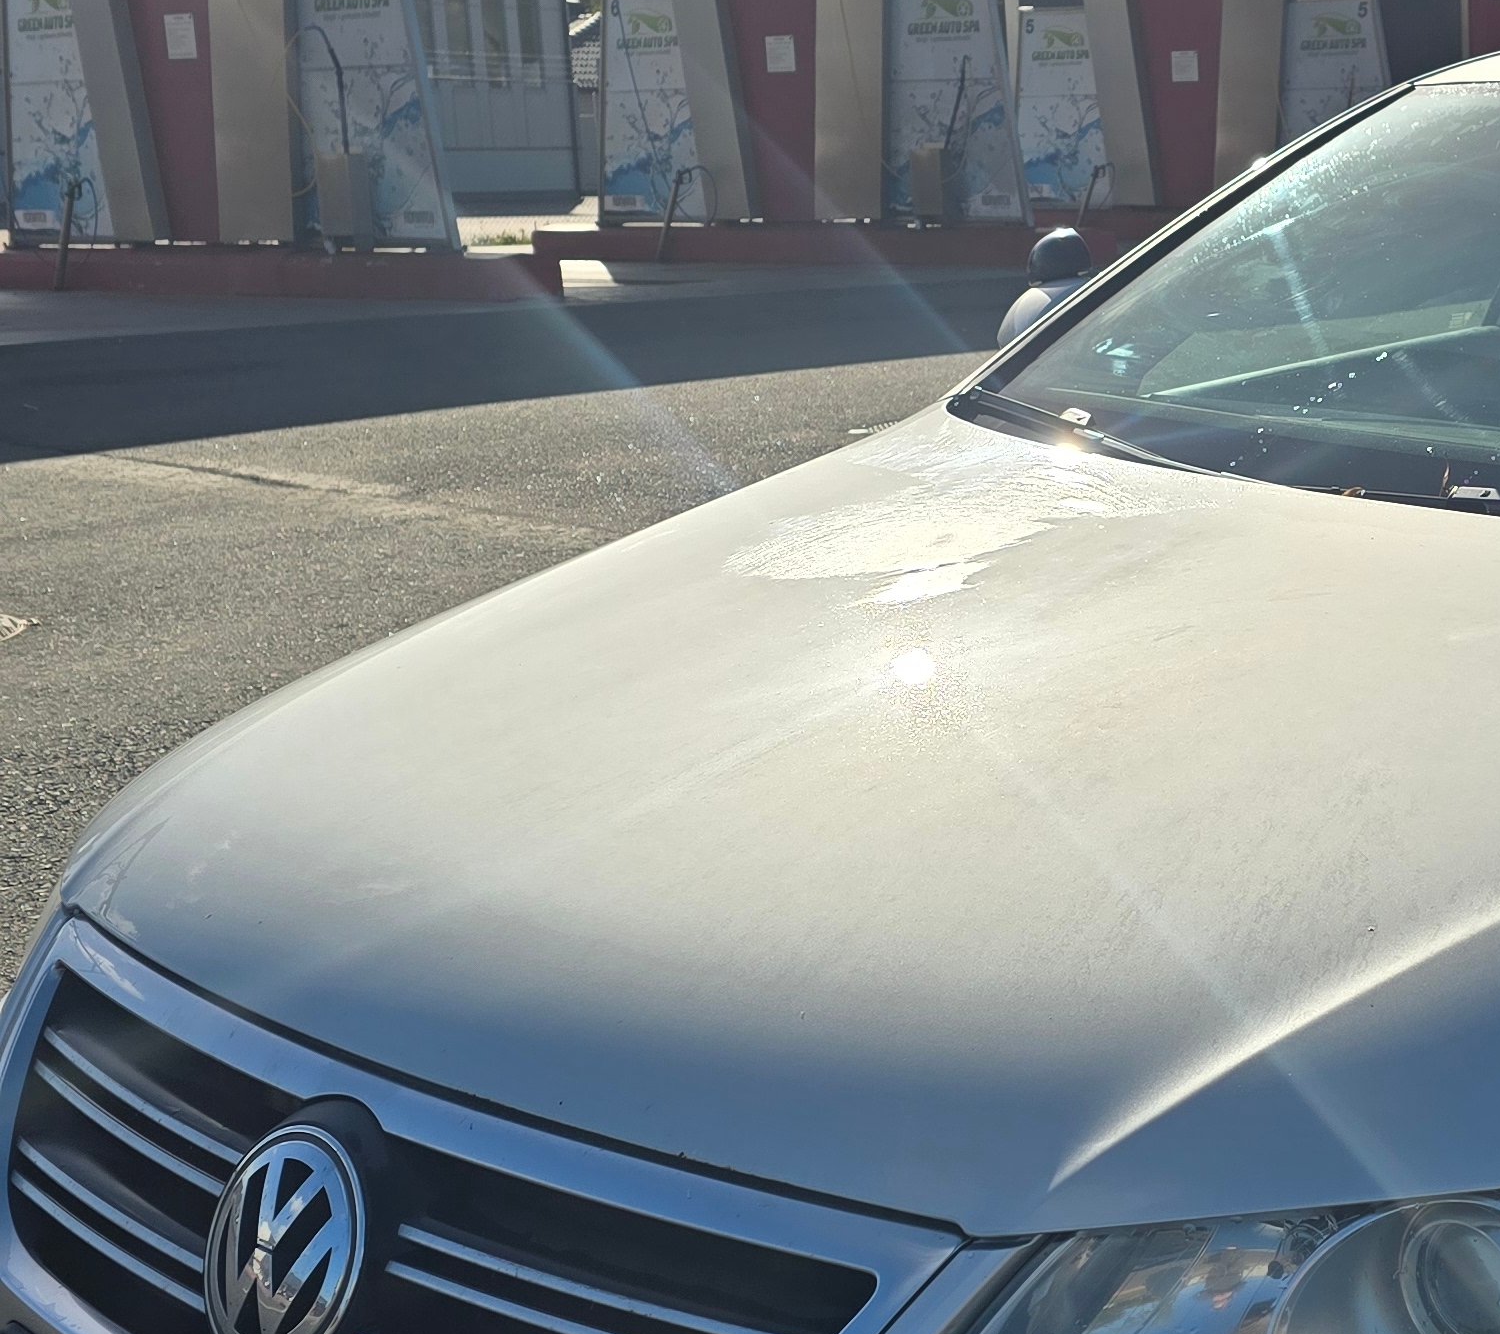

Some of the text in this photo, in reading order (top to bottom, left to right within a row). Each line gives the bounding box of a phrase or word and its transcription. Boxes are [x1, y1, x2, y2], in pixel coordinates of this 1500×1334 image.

[1357, 1, 1368, 18] 5
[907, 19, 980, 36] GREEN AUTO SPA
[1025, 18, 1034, 34] 5
